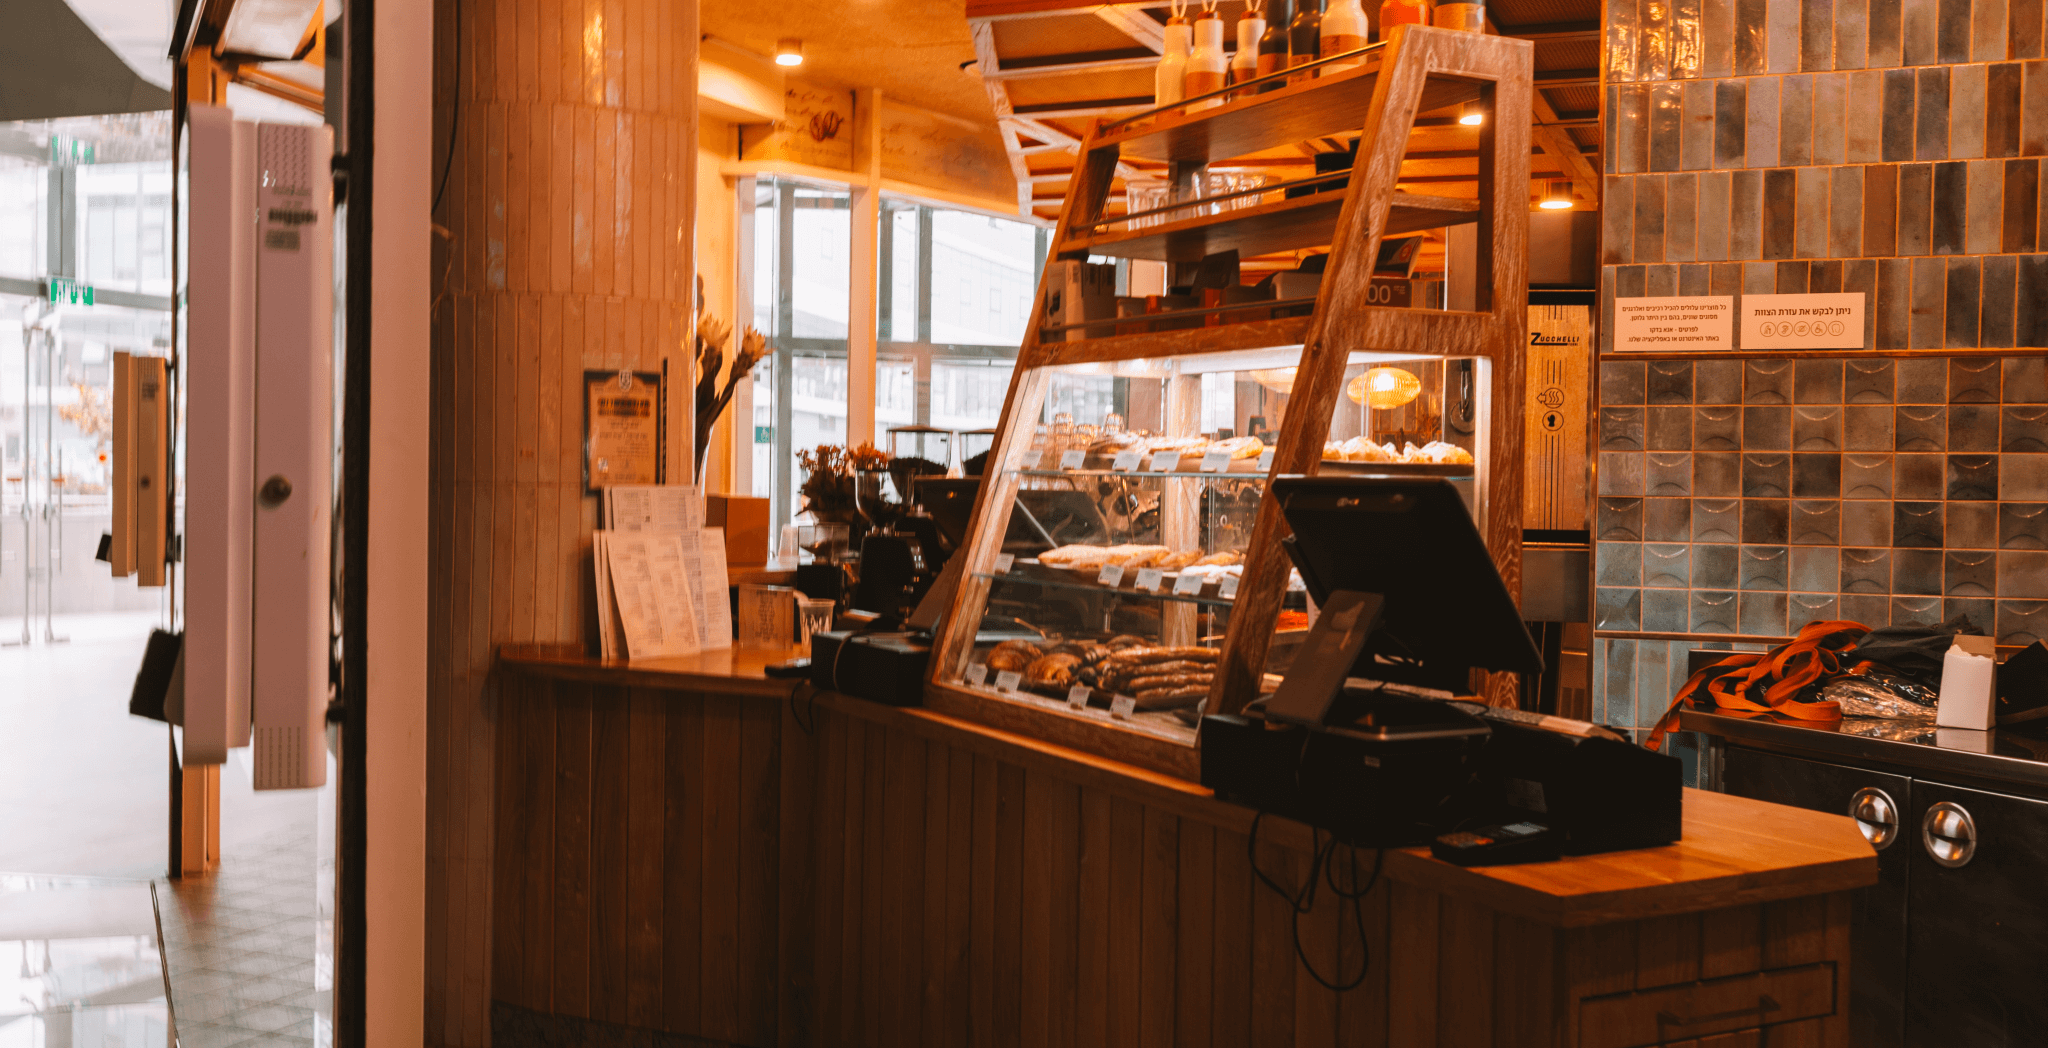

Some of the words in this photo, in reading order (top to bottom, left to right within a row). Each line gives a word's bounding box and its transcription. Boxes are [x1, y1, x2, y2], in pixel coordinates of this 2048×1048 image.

[1754, 308, 1777, 316] הצוות
[1778, 308, 1797, 316] עזרת
[1812, 306, 1834, 316] לבקש
[1836, 307, 1851, 316] ניתן
[1641, 335, 1671, 343] באפליקציה
